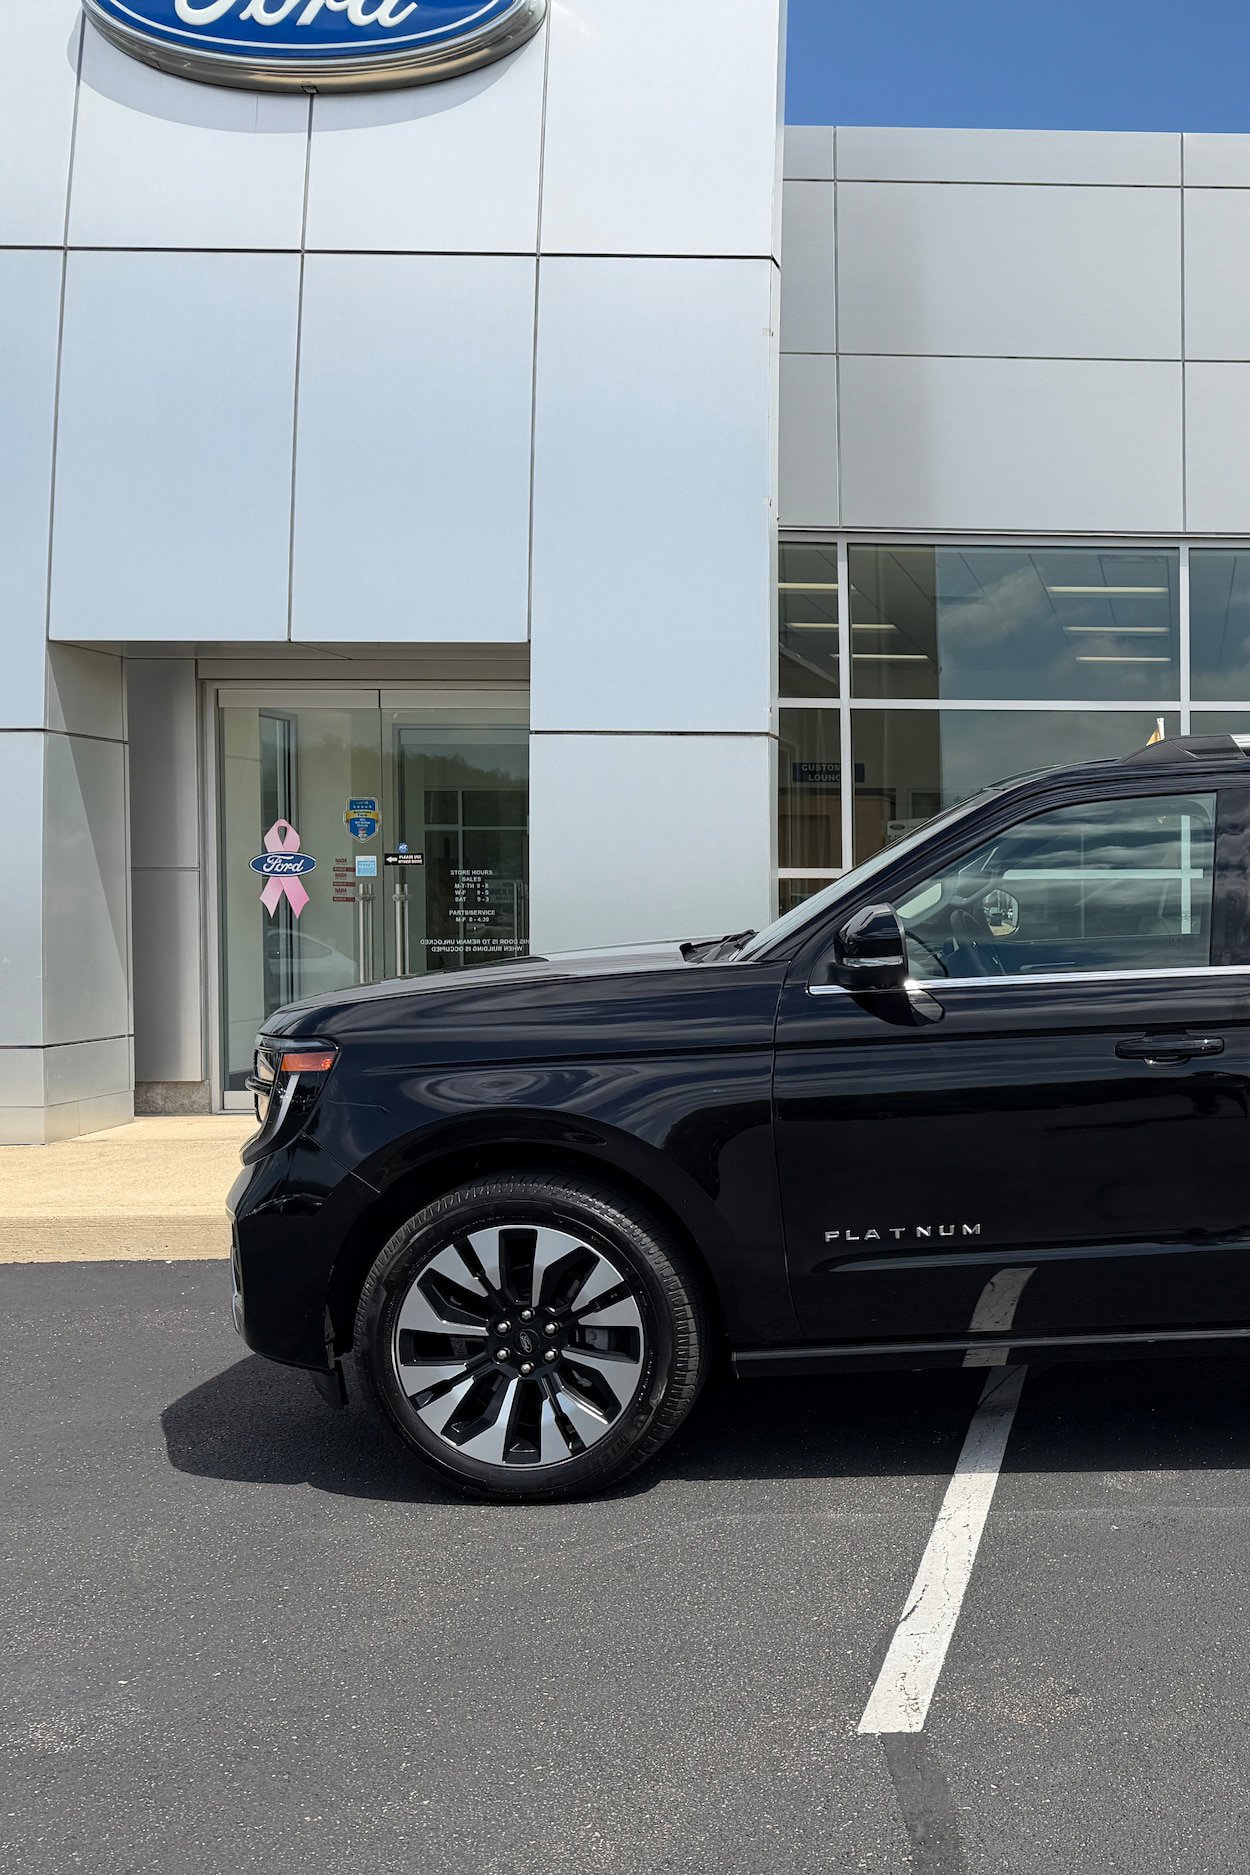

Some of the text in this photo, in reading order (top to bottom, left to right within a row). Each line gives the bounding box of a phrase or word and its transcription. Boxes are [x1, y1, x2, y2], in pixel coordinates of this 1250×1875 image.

[801, 763, 841, 771] CUSTOM
[808, 774, 841, 782] LOUNG
[262, 855, 305, 872] Ford
